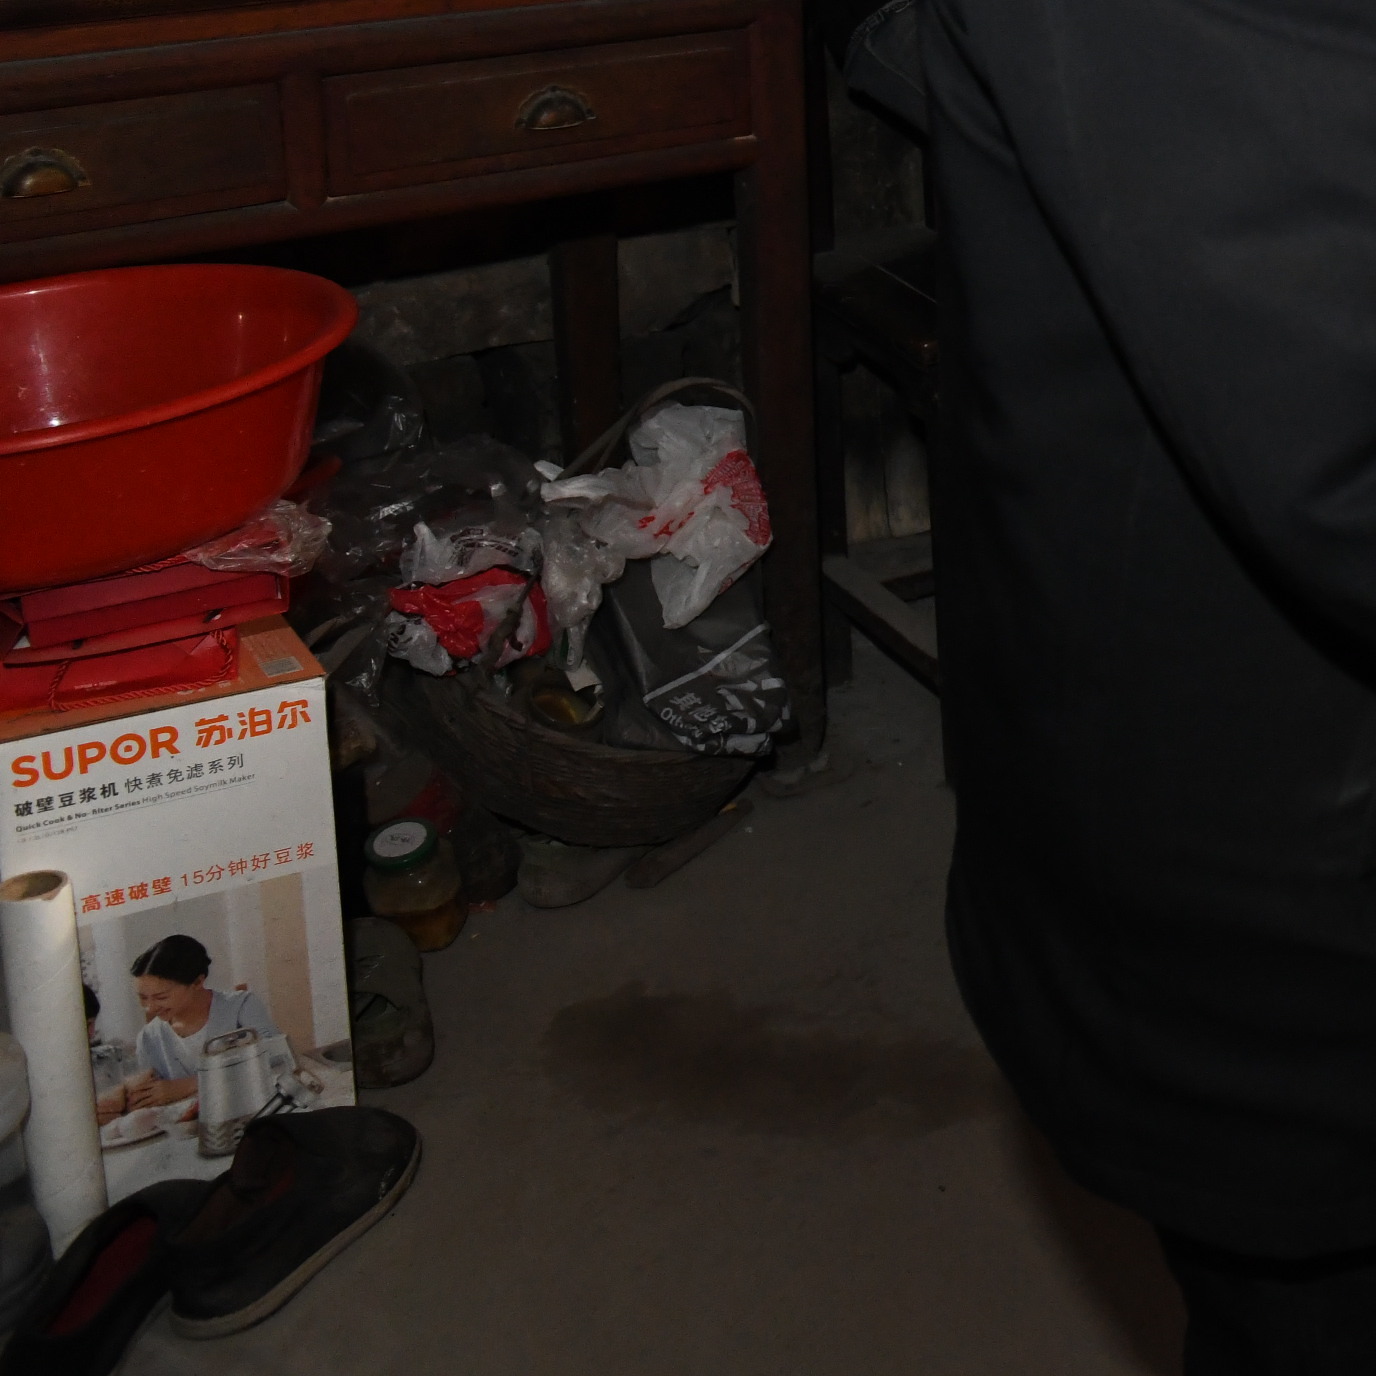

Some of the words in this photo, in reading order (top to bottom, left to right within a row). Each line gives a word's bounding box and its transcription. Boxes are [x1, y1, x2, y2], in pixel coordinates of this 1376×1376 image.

[11, 724, 180, 788] SUPOR
[194, 699, 312, 748] 苏泊尔
[14, 782, 119, 819] 破壁豆浆机
[124, 753, 244, 794] 快煮免滤系列
[16, 821, 42, 834] Quick
[43, 815, 65, 827] Cook
[114, 798, 141, 811] Series
[142, 792, 164, 806] High
[165, 787, 192, 801] Speed
[194, 778, 228, 795] Soymilk
[229, 772, 256, 786] Maker
[81, 876, 172, 914] 高速破壁
[180, 841, 315, 888] 15分钟好豆浆
